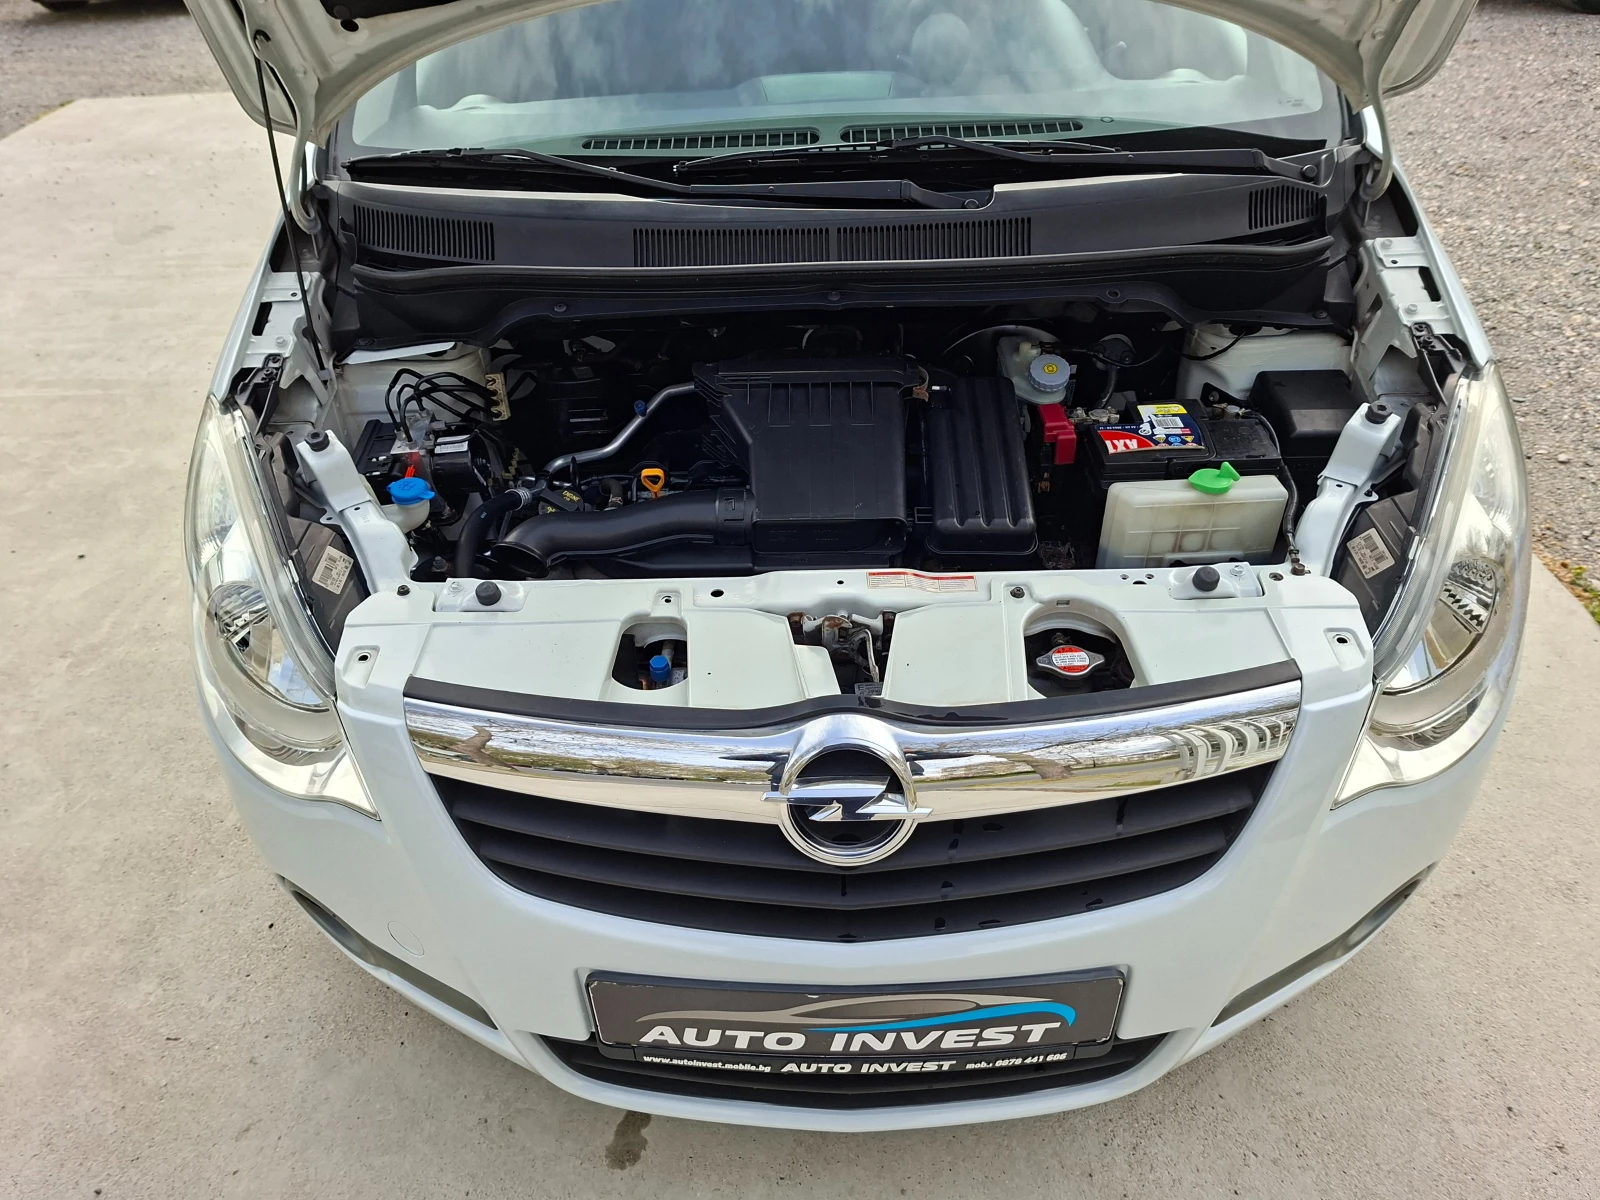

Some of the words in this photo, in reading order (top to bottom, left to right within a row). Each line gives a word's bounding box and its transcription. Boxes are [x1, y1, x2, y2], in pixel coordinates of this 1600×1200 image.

[639, 1025, 806, 1051] AUTO
[829, 1021, 1062, 1052] INVEST
[1024, 1055, 1044, 1064] 441
[780, 1063, 852, 1073] AUTO
[860, 1060, 957, 1073] INVEST
